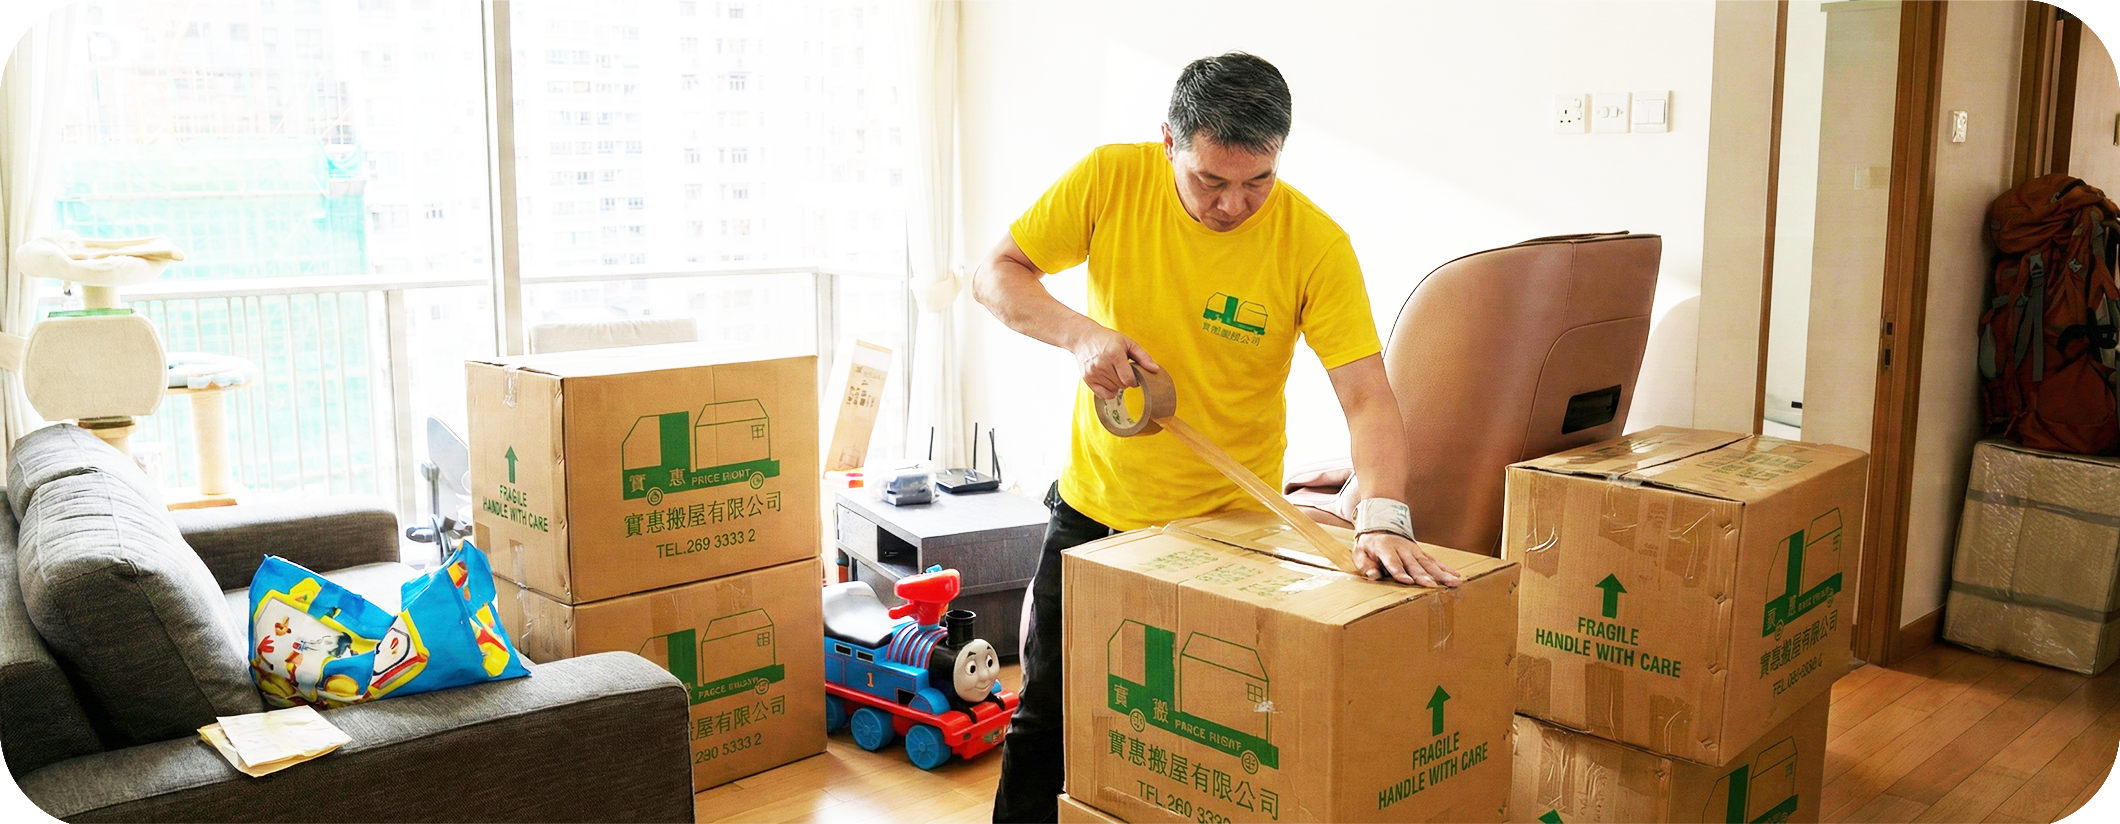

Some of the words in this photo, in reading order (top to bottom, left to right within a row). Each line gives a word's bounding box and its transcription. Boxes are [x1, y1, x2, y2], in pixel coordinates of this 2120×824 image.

[500, 484, 527, 508] FRAGILE
[692, 473, 720, 486] PRICE
[483, 496, 508, 519] HANDLE
[510, 507, 527, 526] WITH
[528, 512, 549, 533] CARE
[624, 490, 781, 538] 實惠搬屋有限公司
[748, 529, 756, 542] 2
[1578, 616, 1640, 646] FRAGILE
[1535, 628, 1591, 657] HANDLE
[1596, 642, 1635, 667] WITH
[1640, 653, 1682, 679] CARE
[866, 672, 875, 688] 1
[754, 732, 762, 746] 2
[1412, 731, 1460, 771] FRAGILE
[1108, 729, 1279, 821] 實惠搬屋有限公司
[1378, 771, 1426, 811] HANDLE
[1428, 756, 1458, 787] WITH
[1461, 741, 1488, 771] CARE
